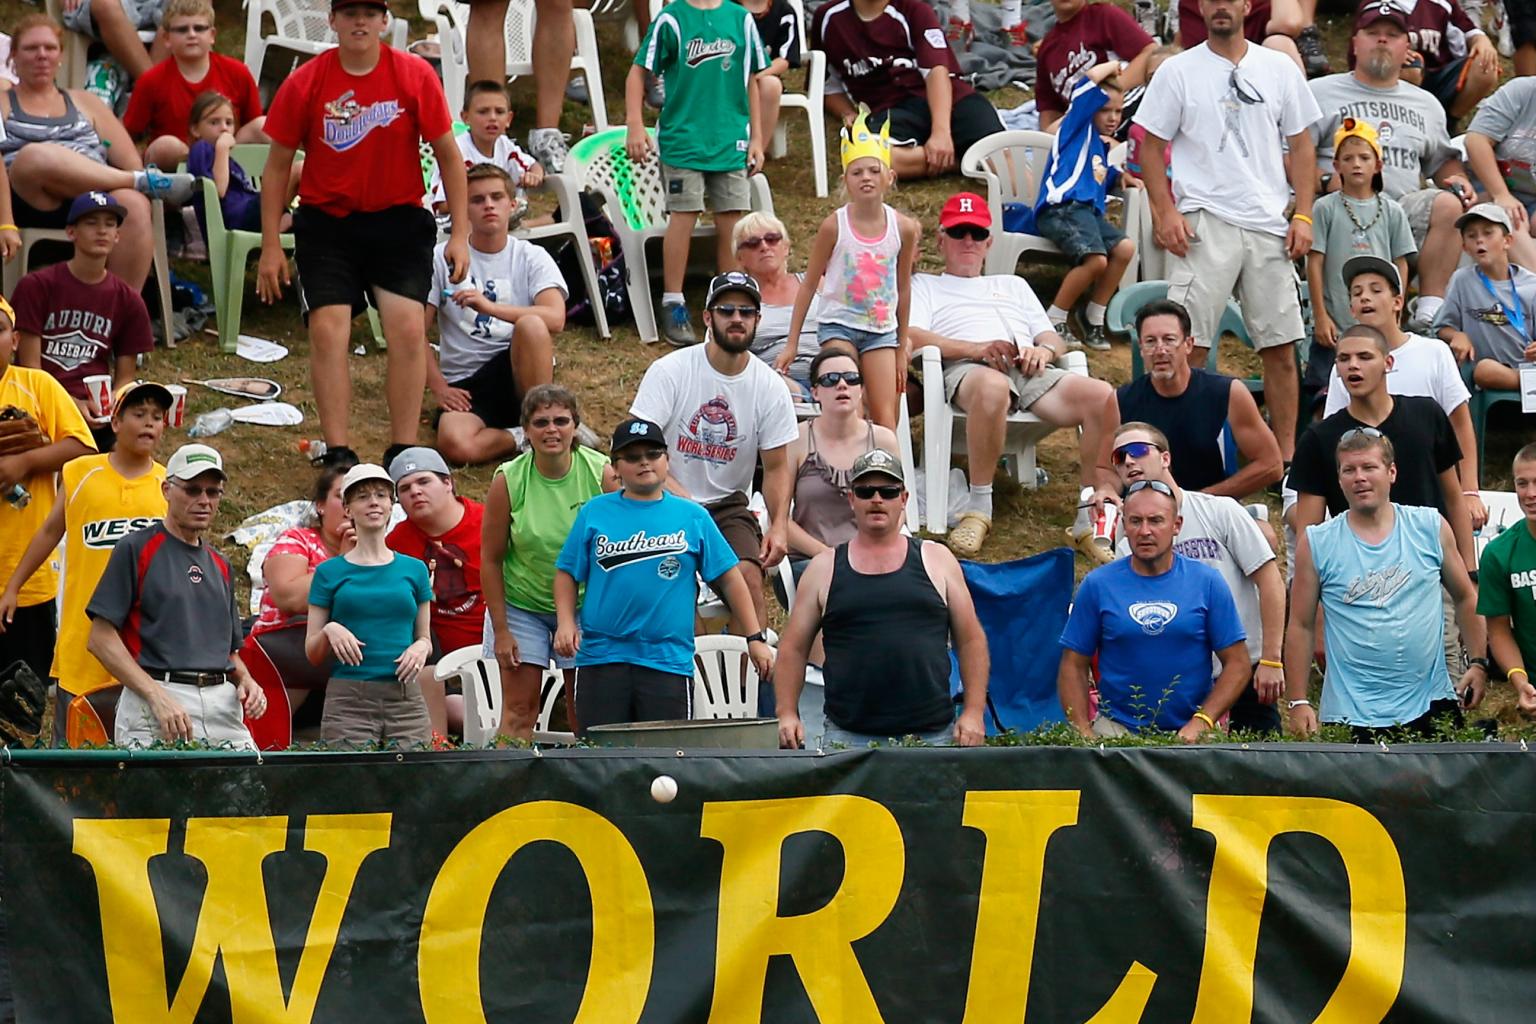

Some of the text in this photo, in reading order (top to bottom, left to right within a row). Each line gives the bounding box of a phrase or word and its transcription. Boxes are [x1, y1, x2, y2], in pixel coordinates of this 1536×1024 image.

[1339, 101, 1426, 134] PITTSBURGH
[959, 198, 973, 212] H
[45, 341, 98, 358] BASEBALL
[596, 531, 685, 556] Southeast
